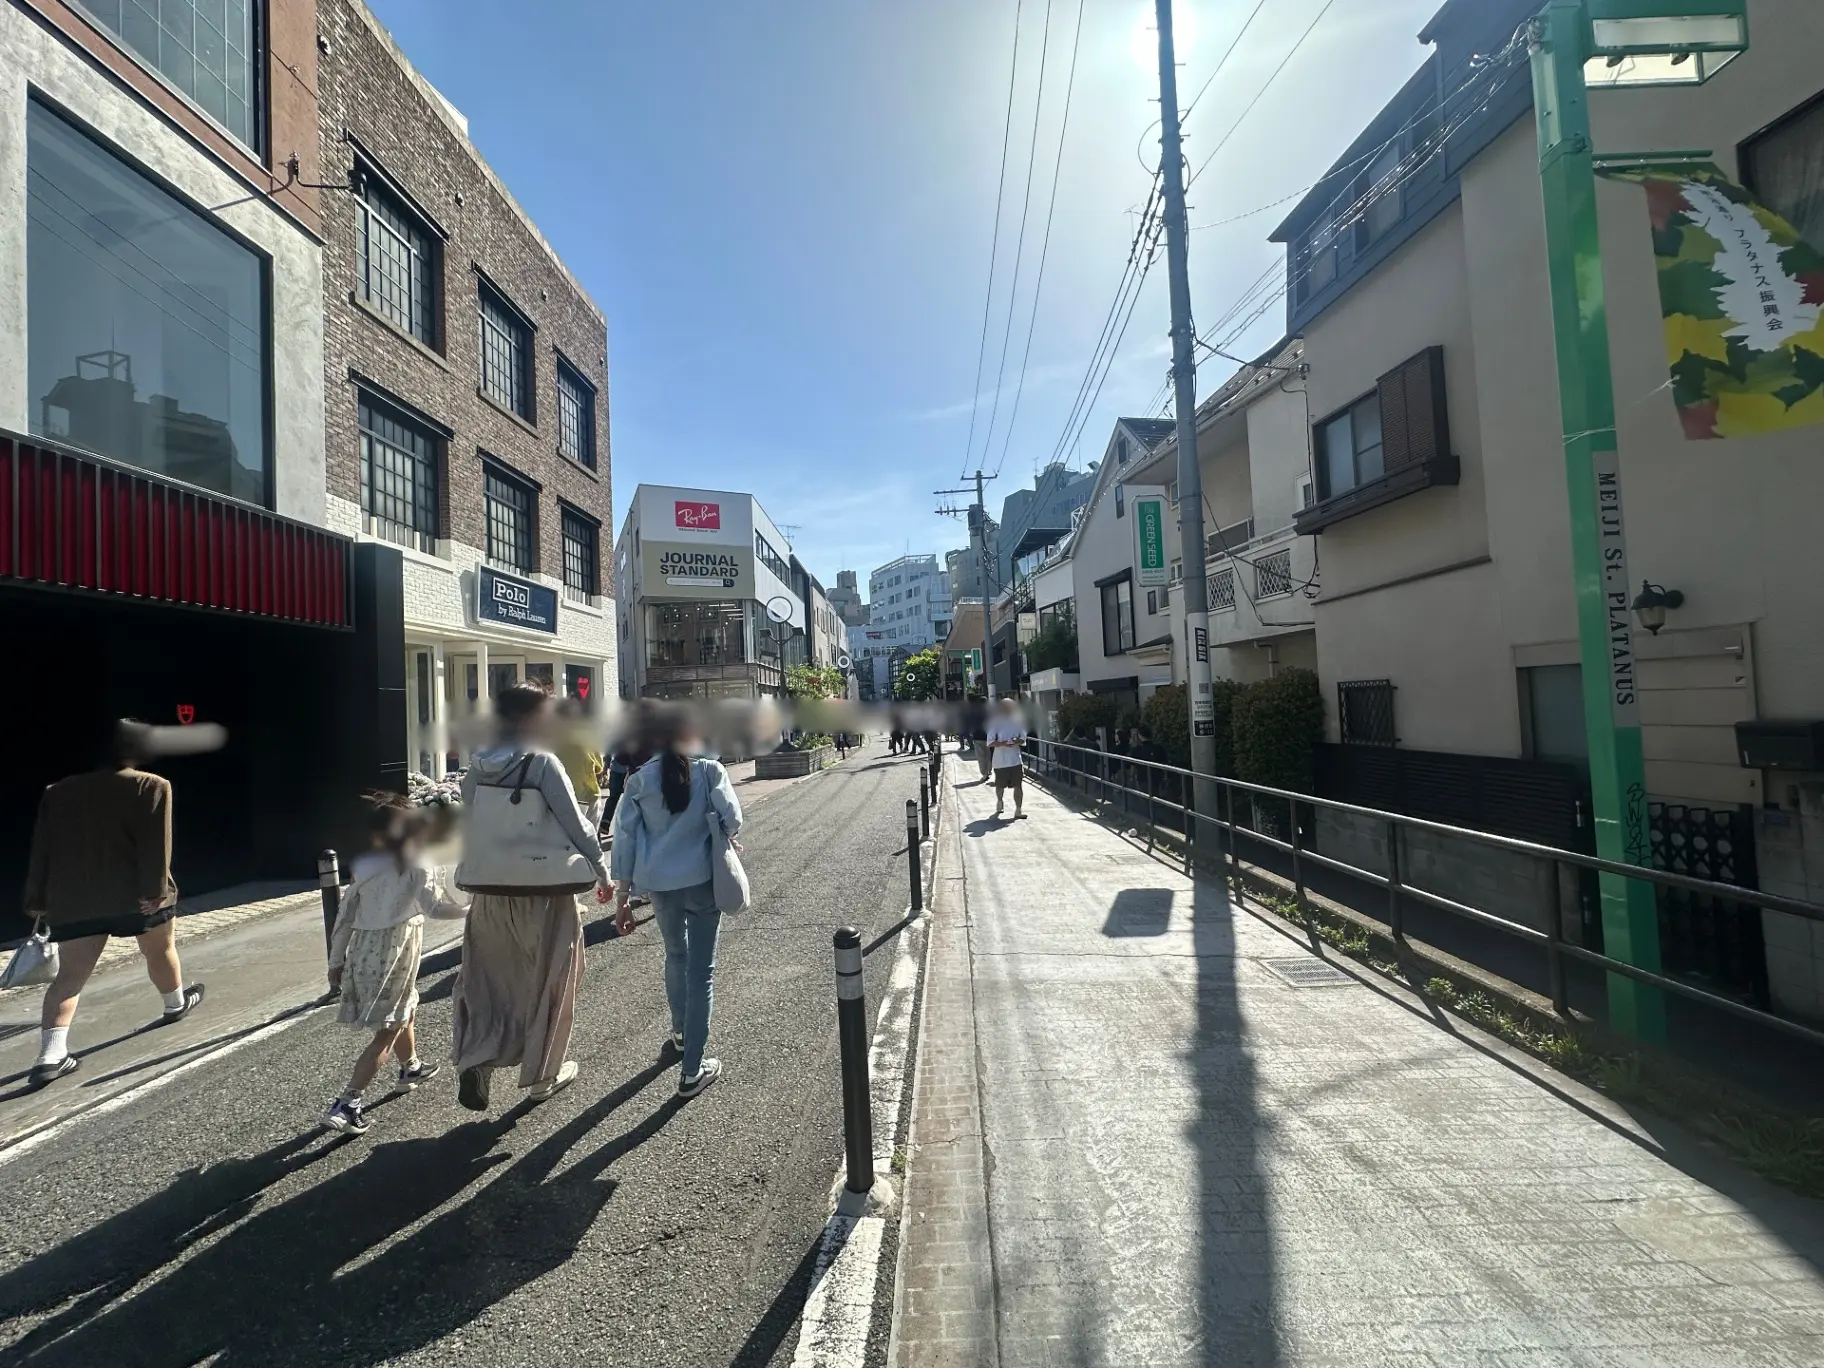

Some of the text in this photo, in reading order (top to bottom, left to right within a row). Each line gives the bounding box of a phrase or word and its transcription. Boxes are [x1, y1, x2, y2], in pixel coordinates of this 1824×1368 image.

[677, 505, 718, 524] Ray-Ban
[659, 551, 739, 567] JOURNAL
[659, 564, 739, 577] STANDARD
[496, 582, 526, 602] Polo
[1598, 472, 1634, 705] MEIJI St. PLATANUS
[498, 603, 507, 617] by
[508, 606, 526, 620] Ralph
